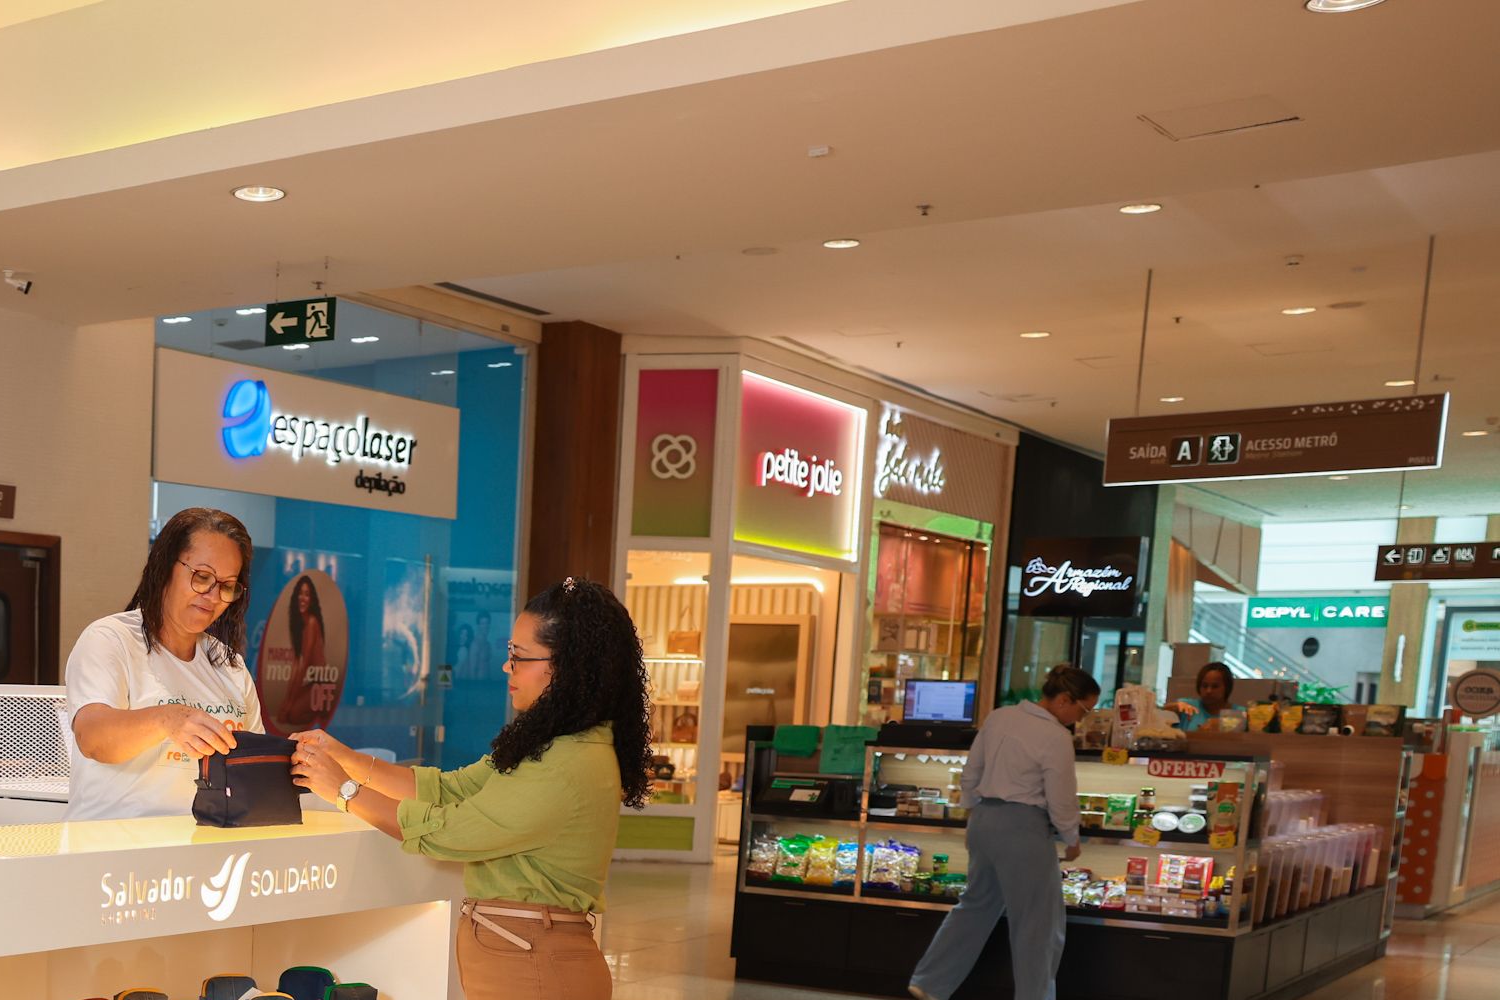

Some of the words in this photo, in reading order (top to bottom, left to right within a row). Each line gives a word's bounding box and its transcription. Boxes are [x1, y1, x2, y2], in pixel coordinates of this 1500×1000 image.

[1128, 443, 1168, 460] SAÍDA
[1176, 440, 1192, 461] A
[1244, 436, 1293, 452] ACESSO
[1294, 433, 1339, 450] METRÔ
[760, 447, 809, 489] petite
[806, 454, 843, 498] jolie
[1250, 605, 1312, 619] DEPYL
[1321, 605, 1386, 618] CARE
[266, 664, 339, 684] moento
[311, 683, 337, 712] OFF
[1149, 759, 1221, 778] OFERTA
[100, 868, 196, 909] Salvador
[250, 859, 338, 898] SOLIDÁRIO
